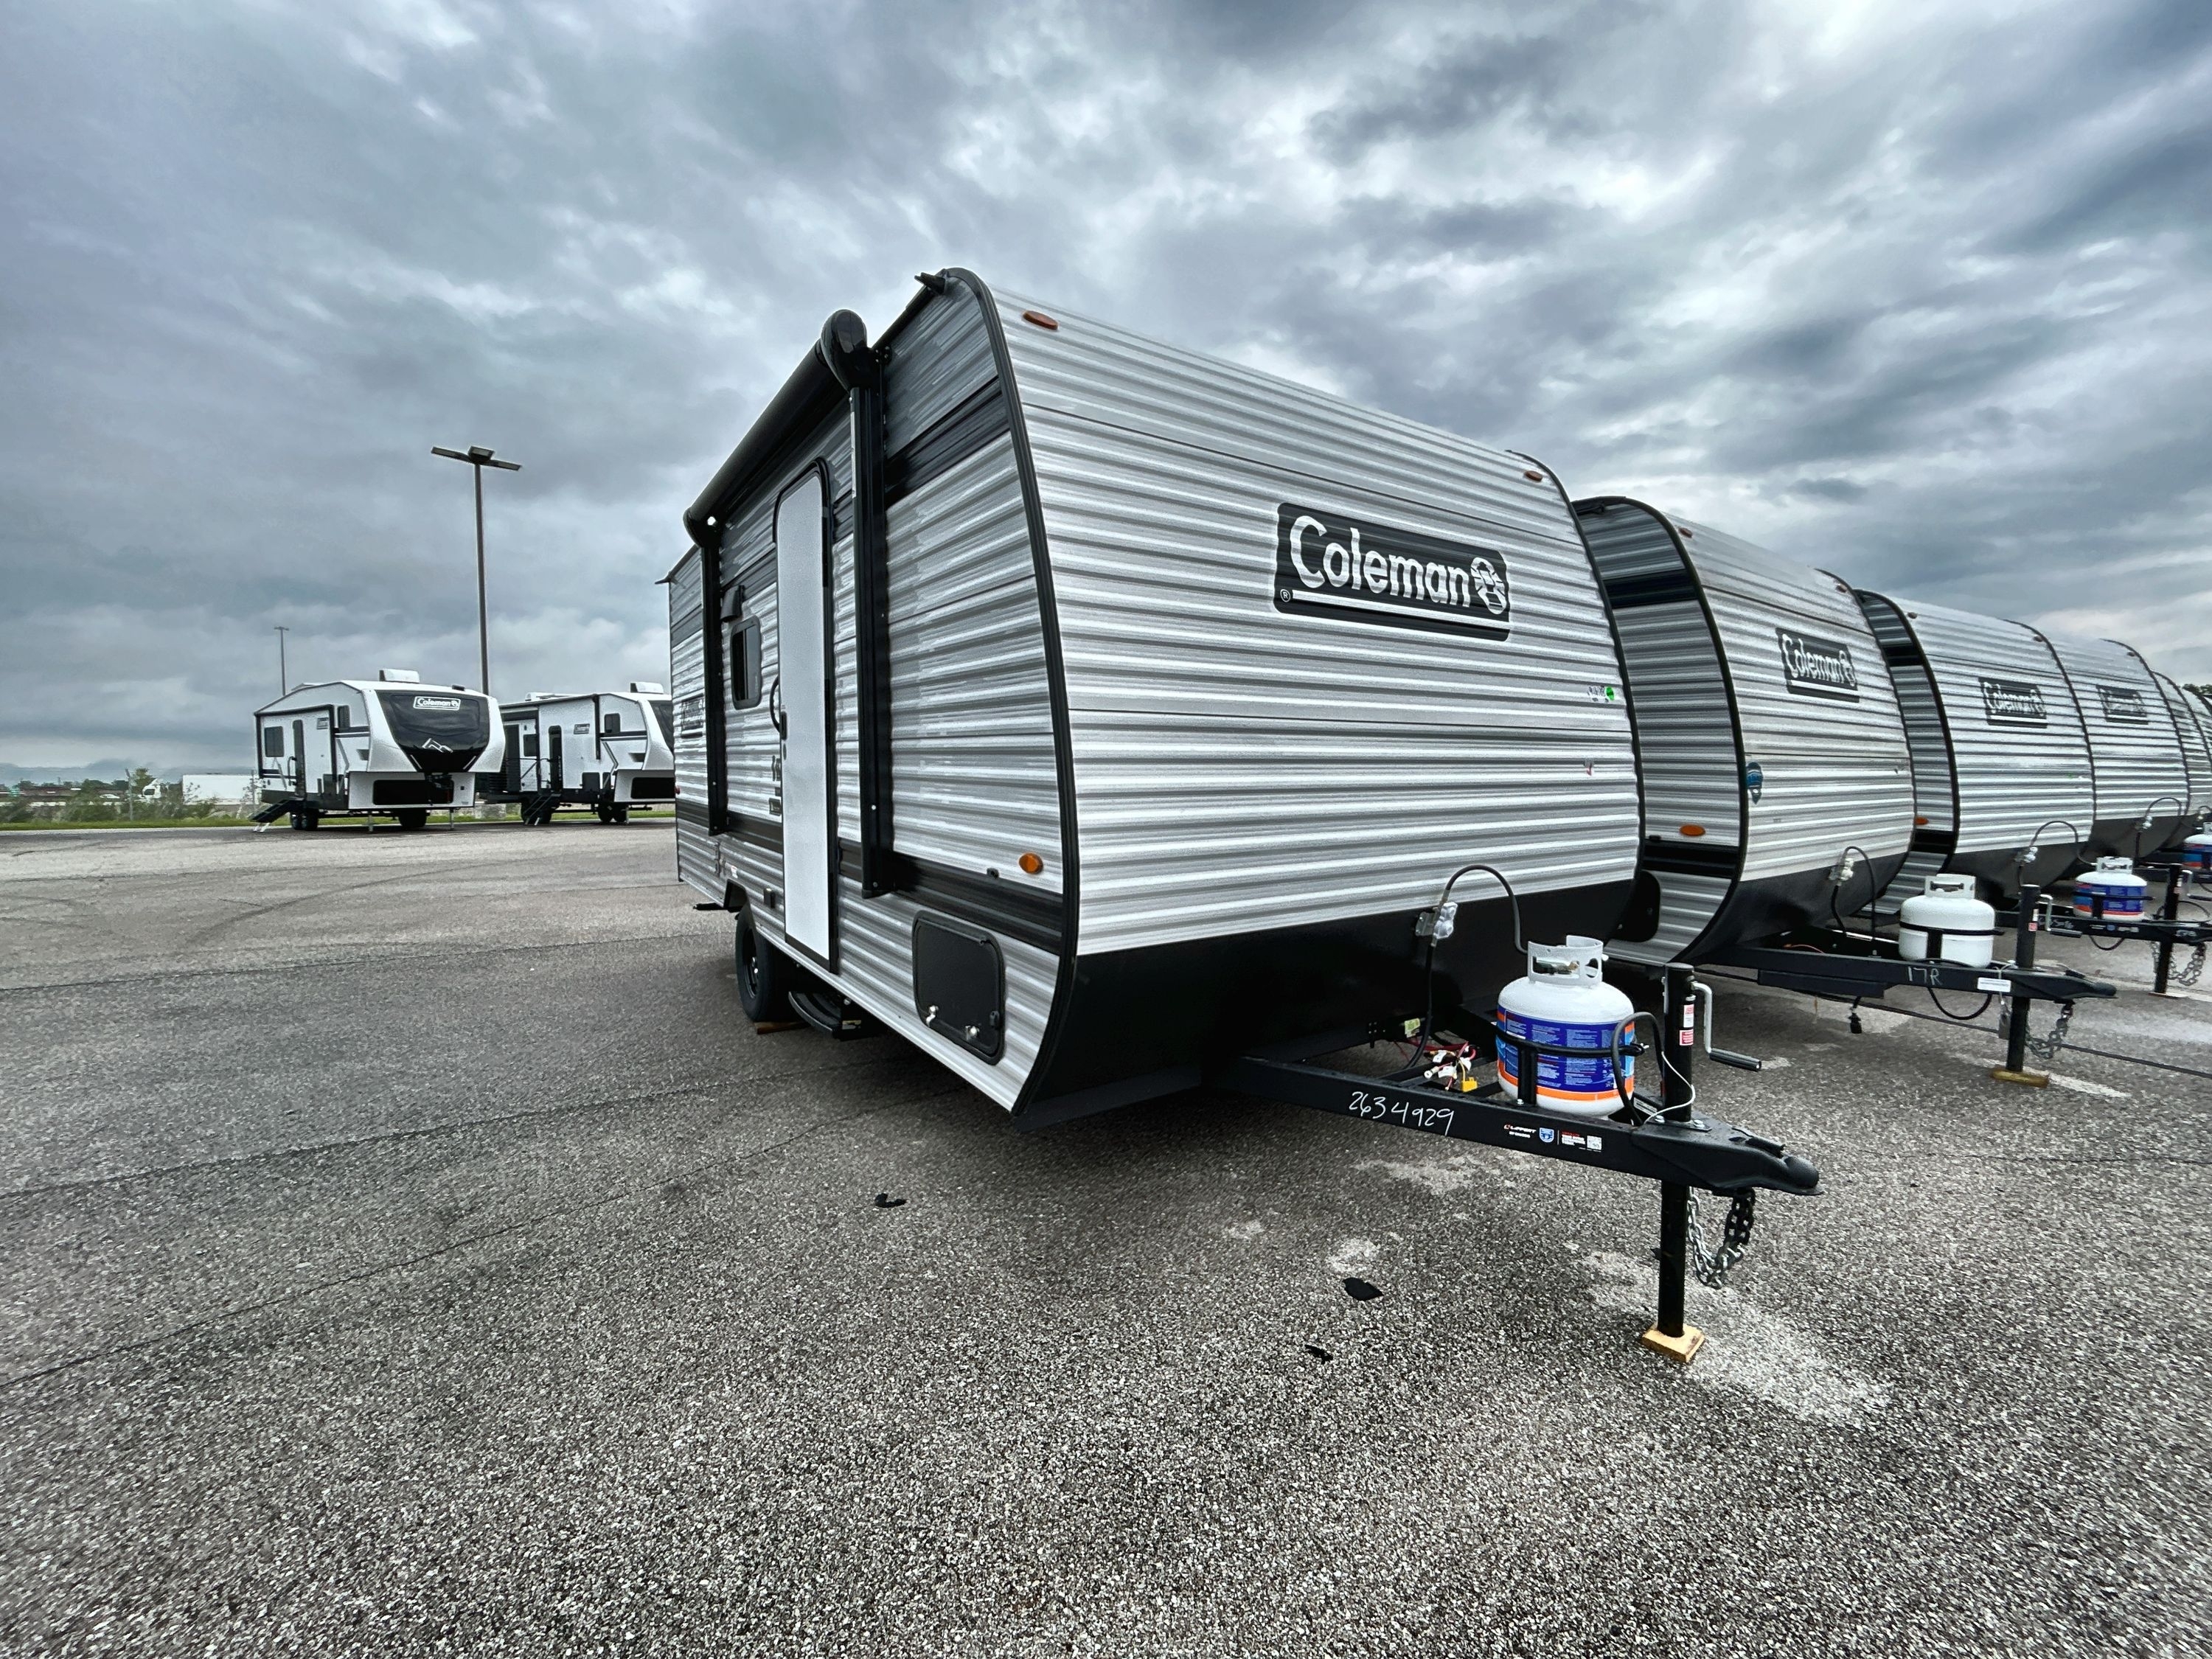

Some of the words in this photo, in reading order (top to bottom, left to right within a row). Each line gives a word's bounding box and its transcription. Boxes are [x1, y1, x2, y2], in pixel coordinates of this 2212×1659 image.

[1290, 515, 1471, 608] Coleman
[1782, 633, 1845, 684] Coleman
[417, 698, 451, 706] Coleman
